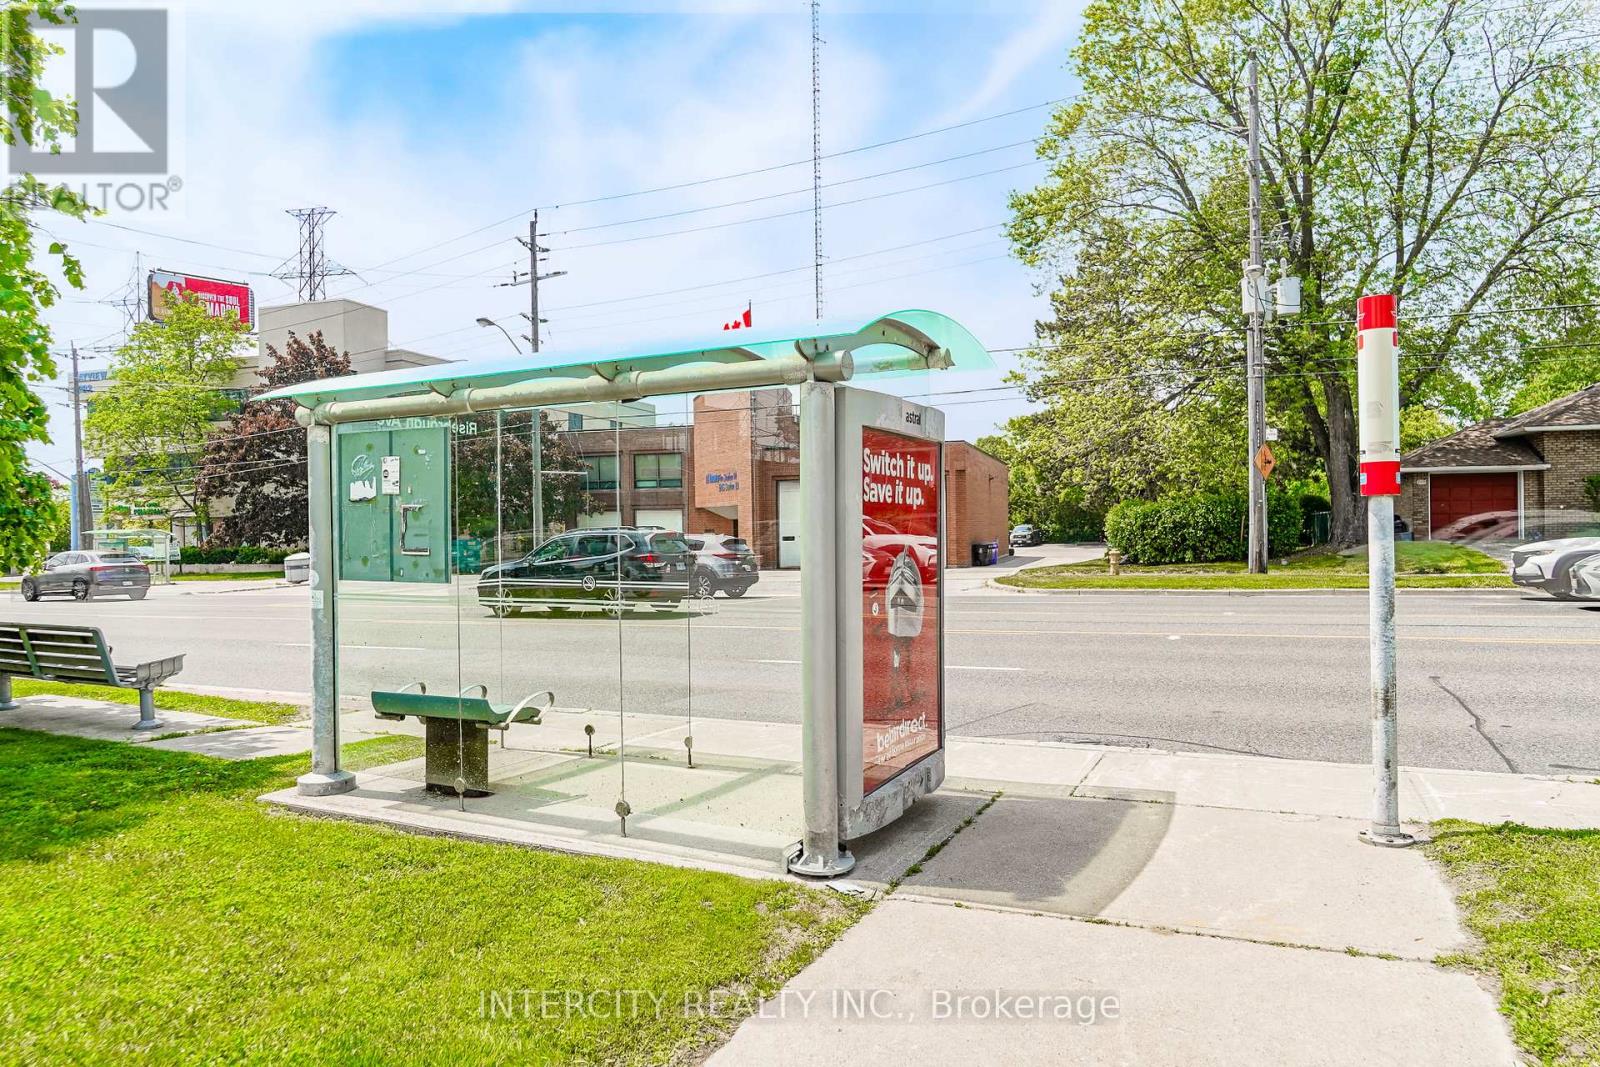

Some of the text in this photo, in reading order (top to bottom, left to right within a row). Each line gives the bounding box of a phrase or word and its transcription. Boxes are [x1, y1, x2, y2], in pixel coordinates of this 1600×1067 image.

[906, 411, 922, 426] astral
[863, 447, 934, 486] Switch it up.
[863, 476, 925, 510] Save it up.
